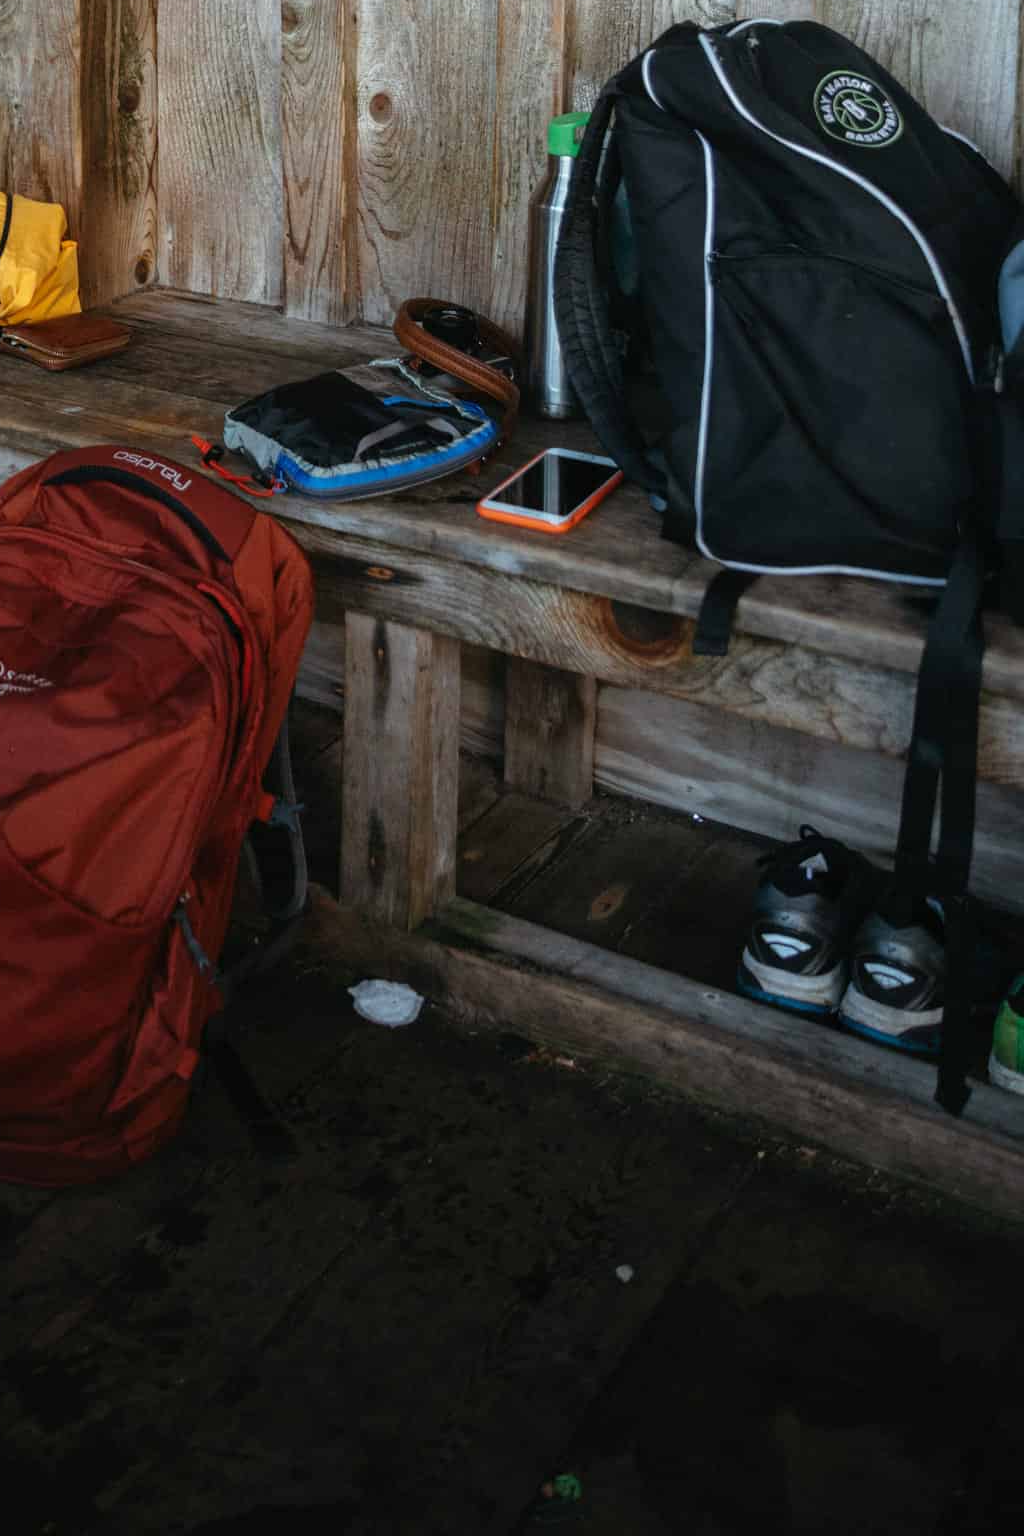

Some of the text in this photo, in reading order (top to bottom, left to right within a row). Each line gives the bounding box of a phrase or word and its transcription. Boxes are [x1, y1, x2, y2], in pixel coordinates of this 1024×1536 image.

[824, 76, 873, 96] NATION
[820, 95, 835, 123] BAY
[113, 450, 192, 492] osprey
